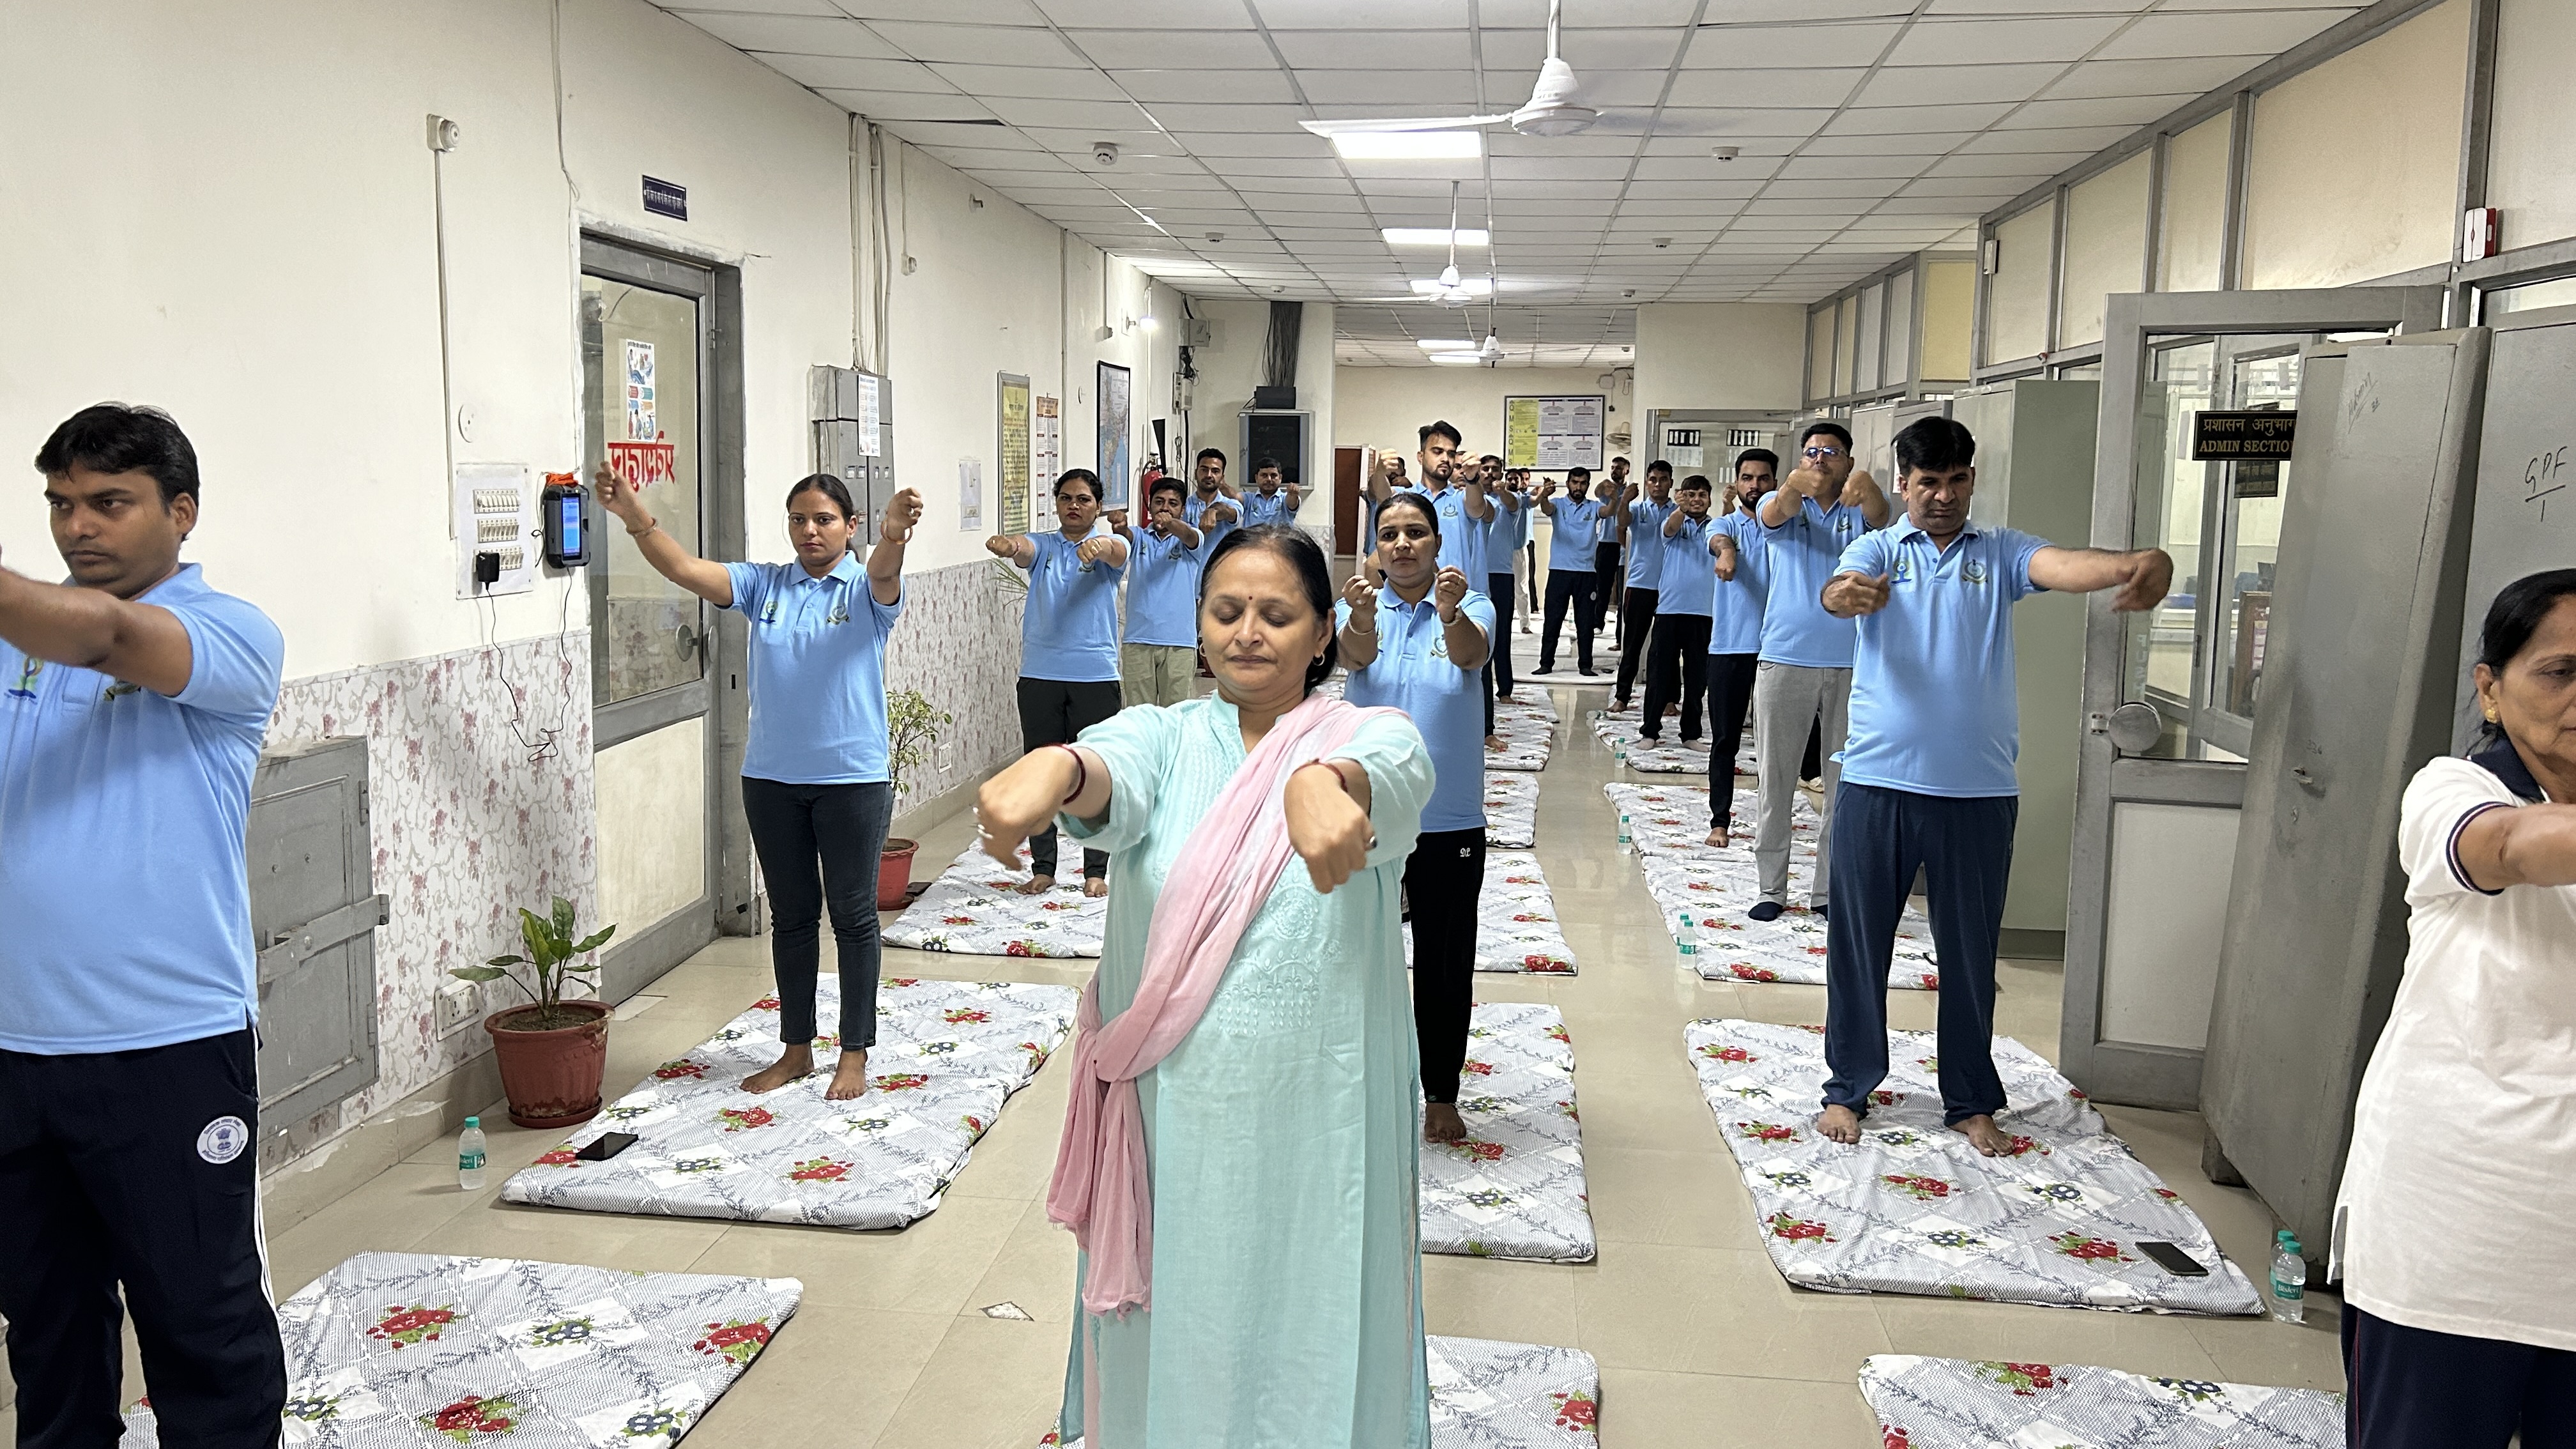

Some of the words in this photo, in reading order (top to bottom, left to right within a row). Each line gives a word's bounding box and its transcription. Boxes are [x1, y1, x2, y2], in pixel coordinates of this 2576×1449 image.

[2204, 418, 2246, 432] प्रशासन
[2199, 440, 2241, 452] ADMIN
[2524, 446, 2568, 494] GPF
